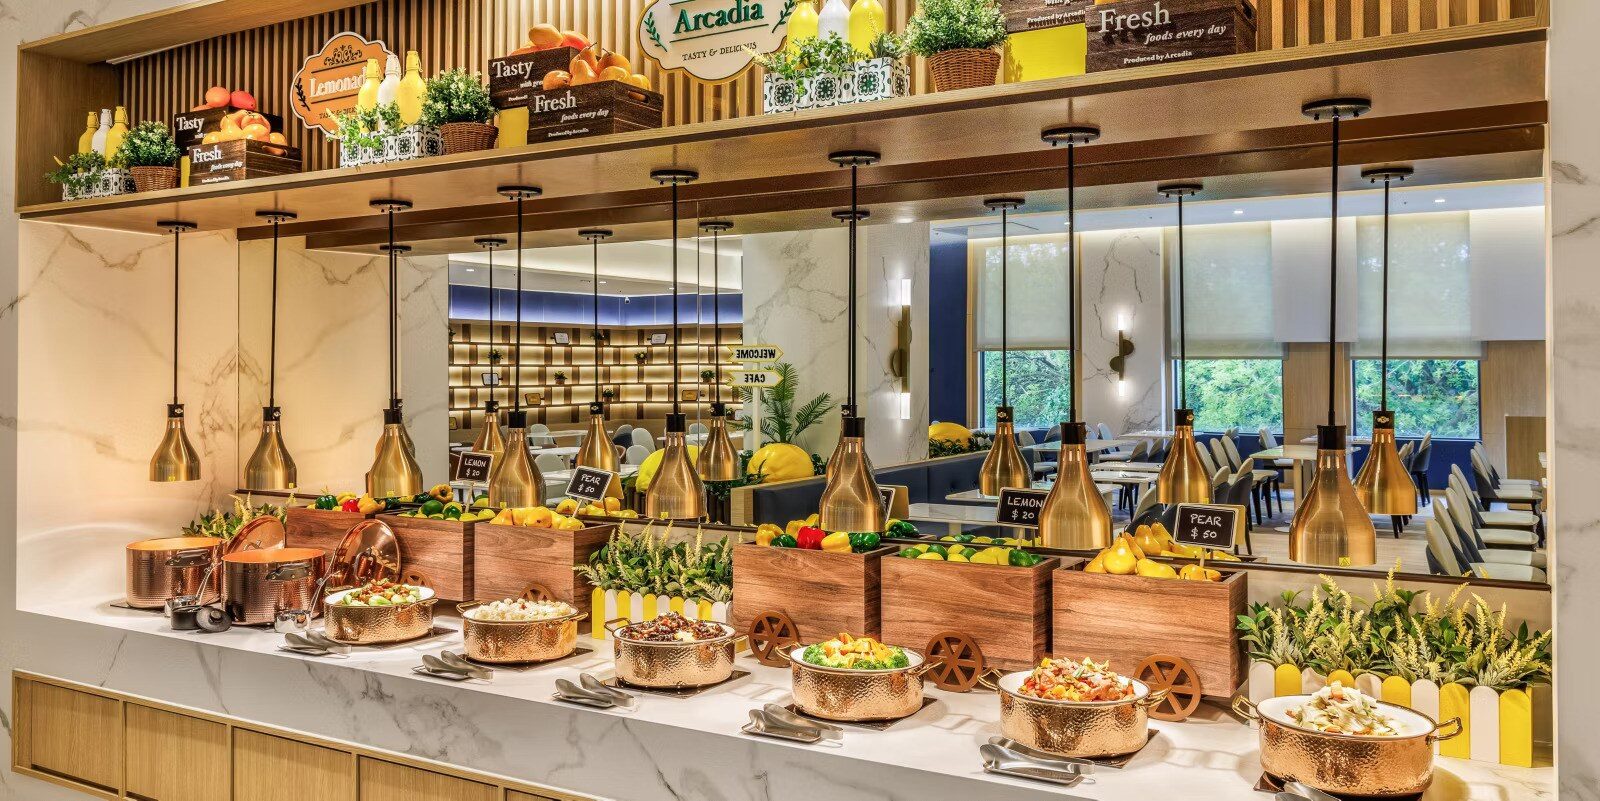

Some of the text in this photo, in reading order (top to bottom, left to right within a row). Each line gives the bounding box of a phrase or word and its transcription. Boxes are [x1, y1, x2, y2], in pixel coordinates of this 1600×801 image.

[673, 0, 765, 34] Arcadia
[1026, 14, 1055, 23] Produced
[1098, 1, 1172, 33] Fresh
[1144, 24, 1227, 45] foods every day
[682, 50, 707, 61] TASTY
[709, 48, 718, 56] &
[1123, 53, 1156, 64] Produced
[1164, 50, 1193, 60] Arcadia
[492, 60, 534, 79] Tasty
[310, 66, 367, 97] Lemonad
[533, 90, 578, 114] Fresh
[597, 108, 610, 117] day
[176, 116, 204, 132] Tasty
[192, 145, 223, 164] Fresh
[464, 457, 487, 468] LEMON
[581, 473, 601, 485] PEAR
[1007, 496, 1044, 508] LEMON
[1022, 511, 1035, 520] 20
[1190, 513, 1222, 527] PEAR
